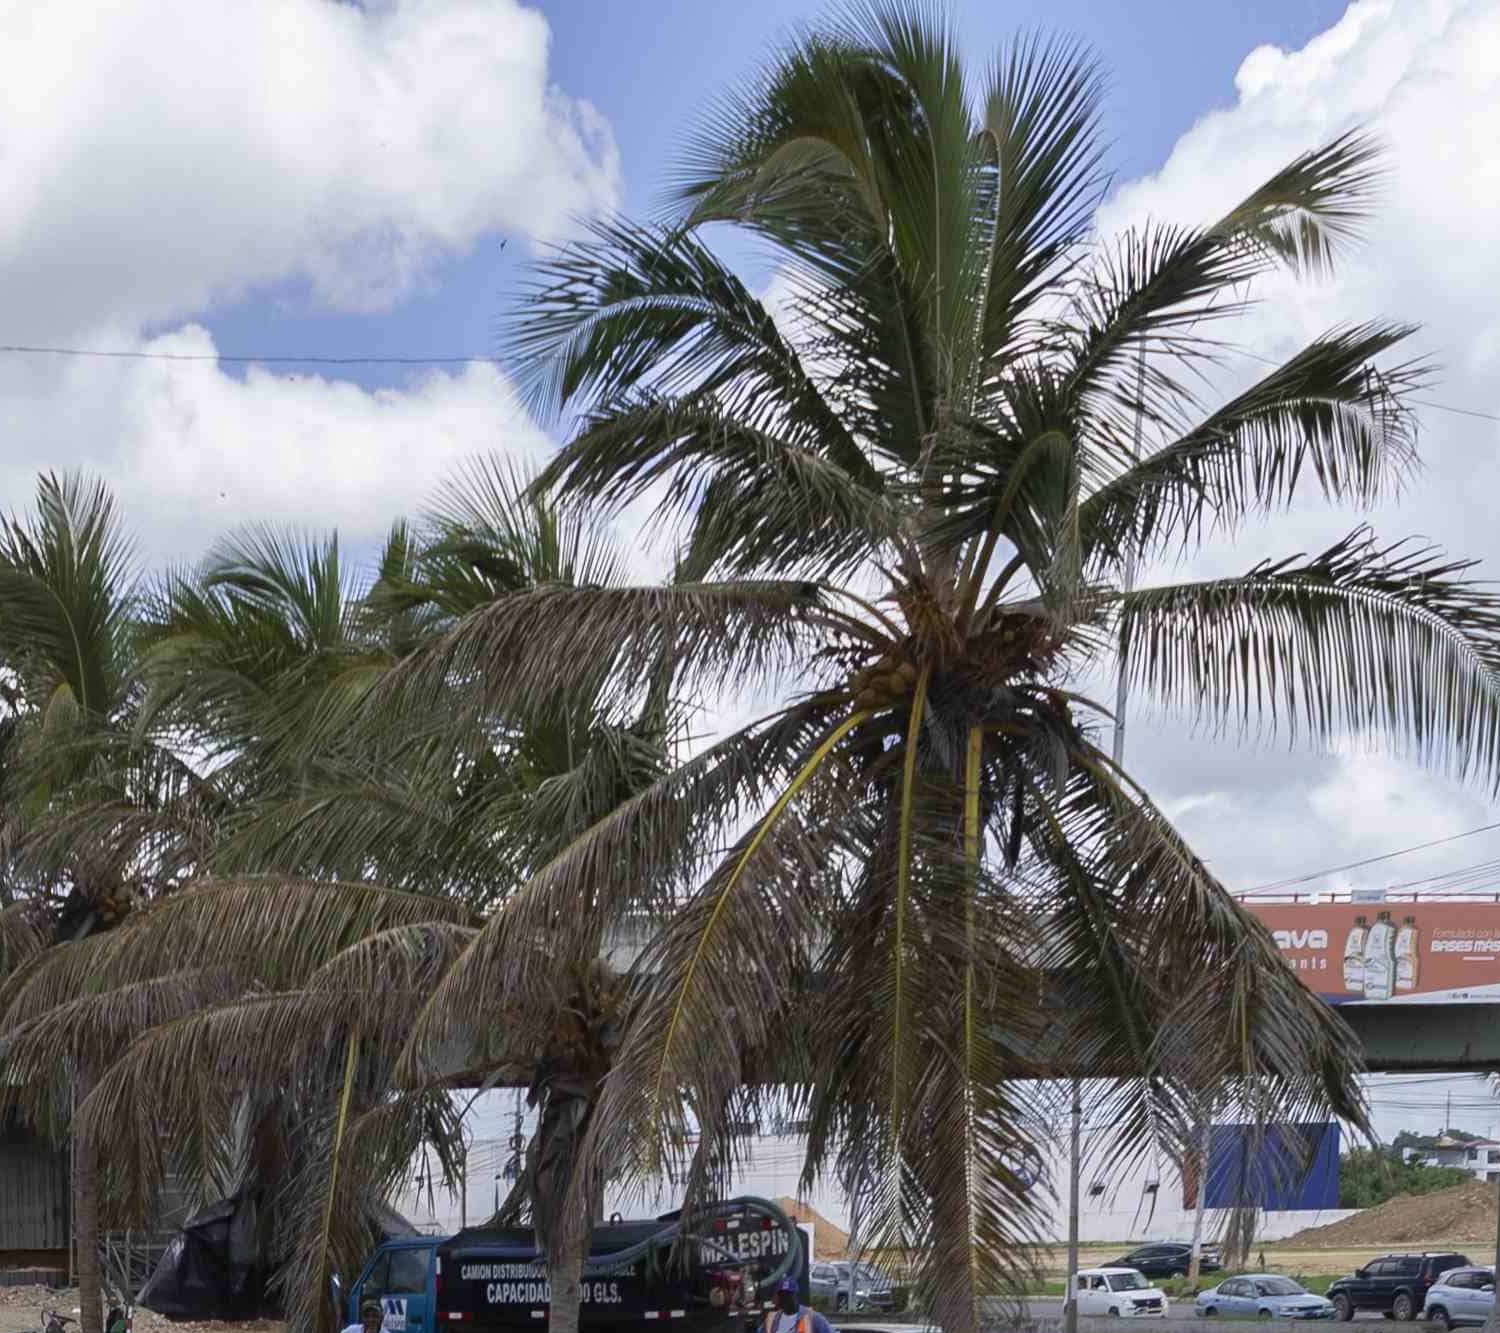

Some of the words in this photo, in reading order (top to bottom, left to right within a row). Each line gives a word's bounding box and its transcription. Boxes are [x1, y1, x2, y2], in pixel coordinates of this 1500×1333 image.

[1272, 929, 1328, 949] ava
[1430, 940, 1473, 952] BASES
[700, 1229, 789, 1265] MALESPIN
[461, 1264, 492, 1280] CAMION
[486, 1283, 552, 1303] CAPACIDAD
[593, 1283, 622, 1303] GLS.
